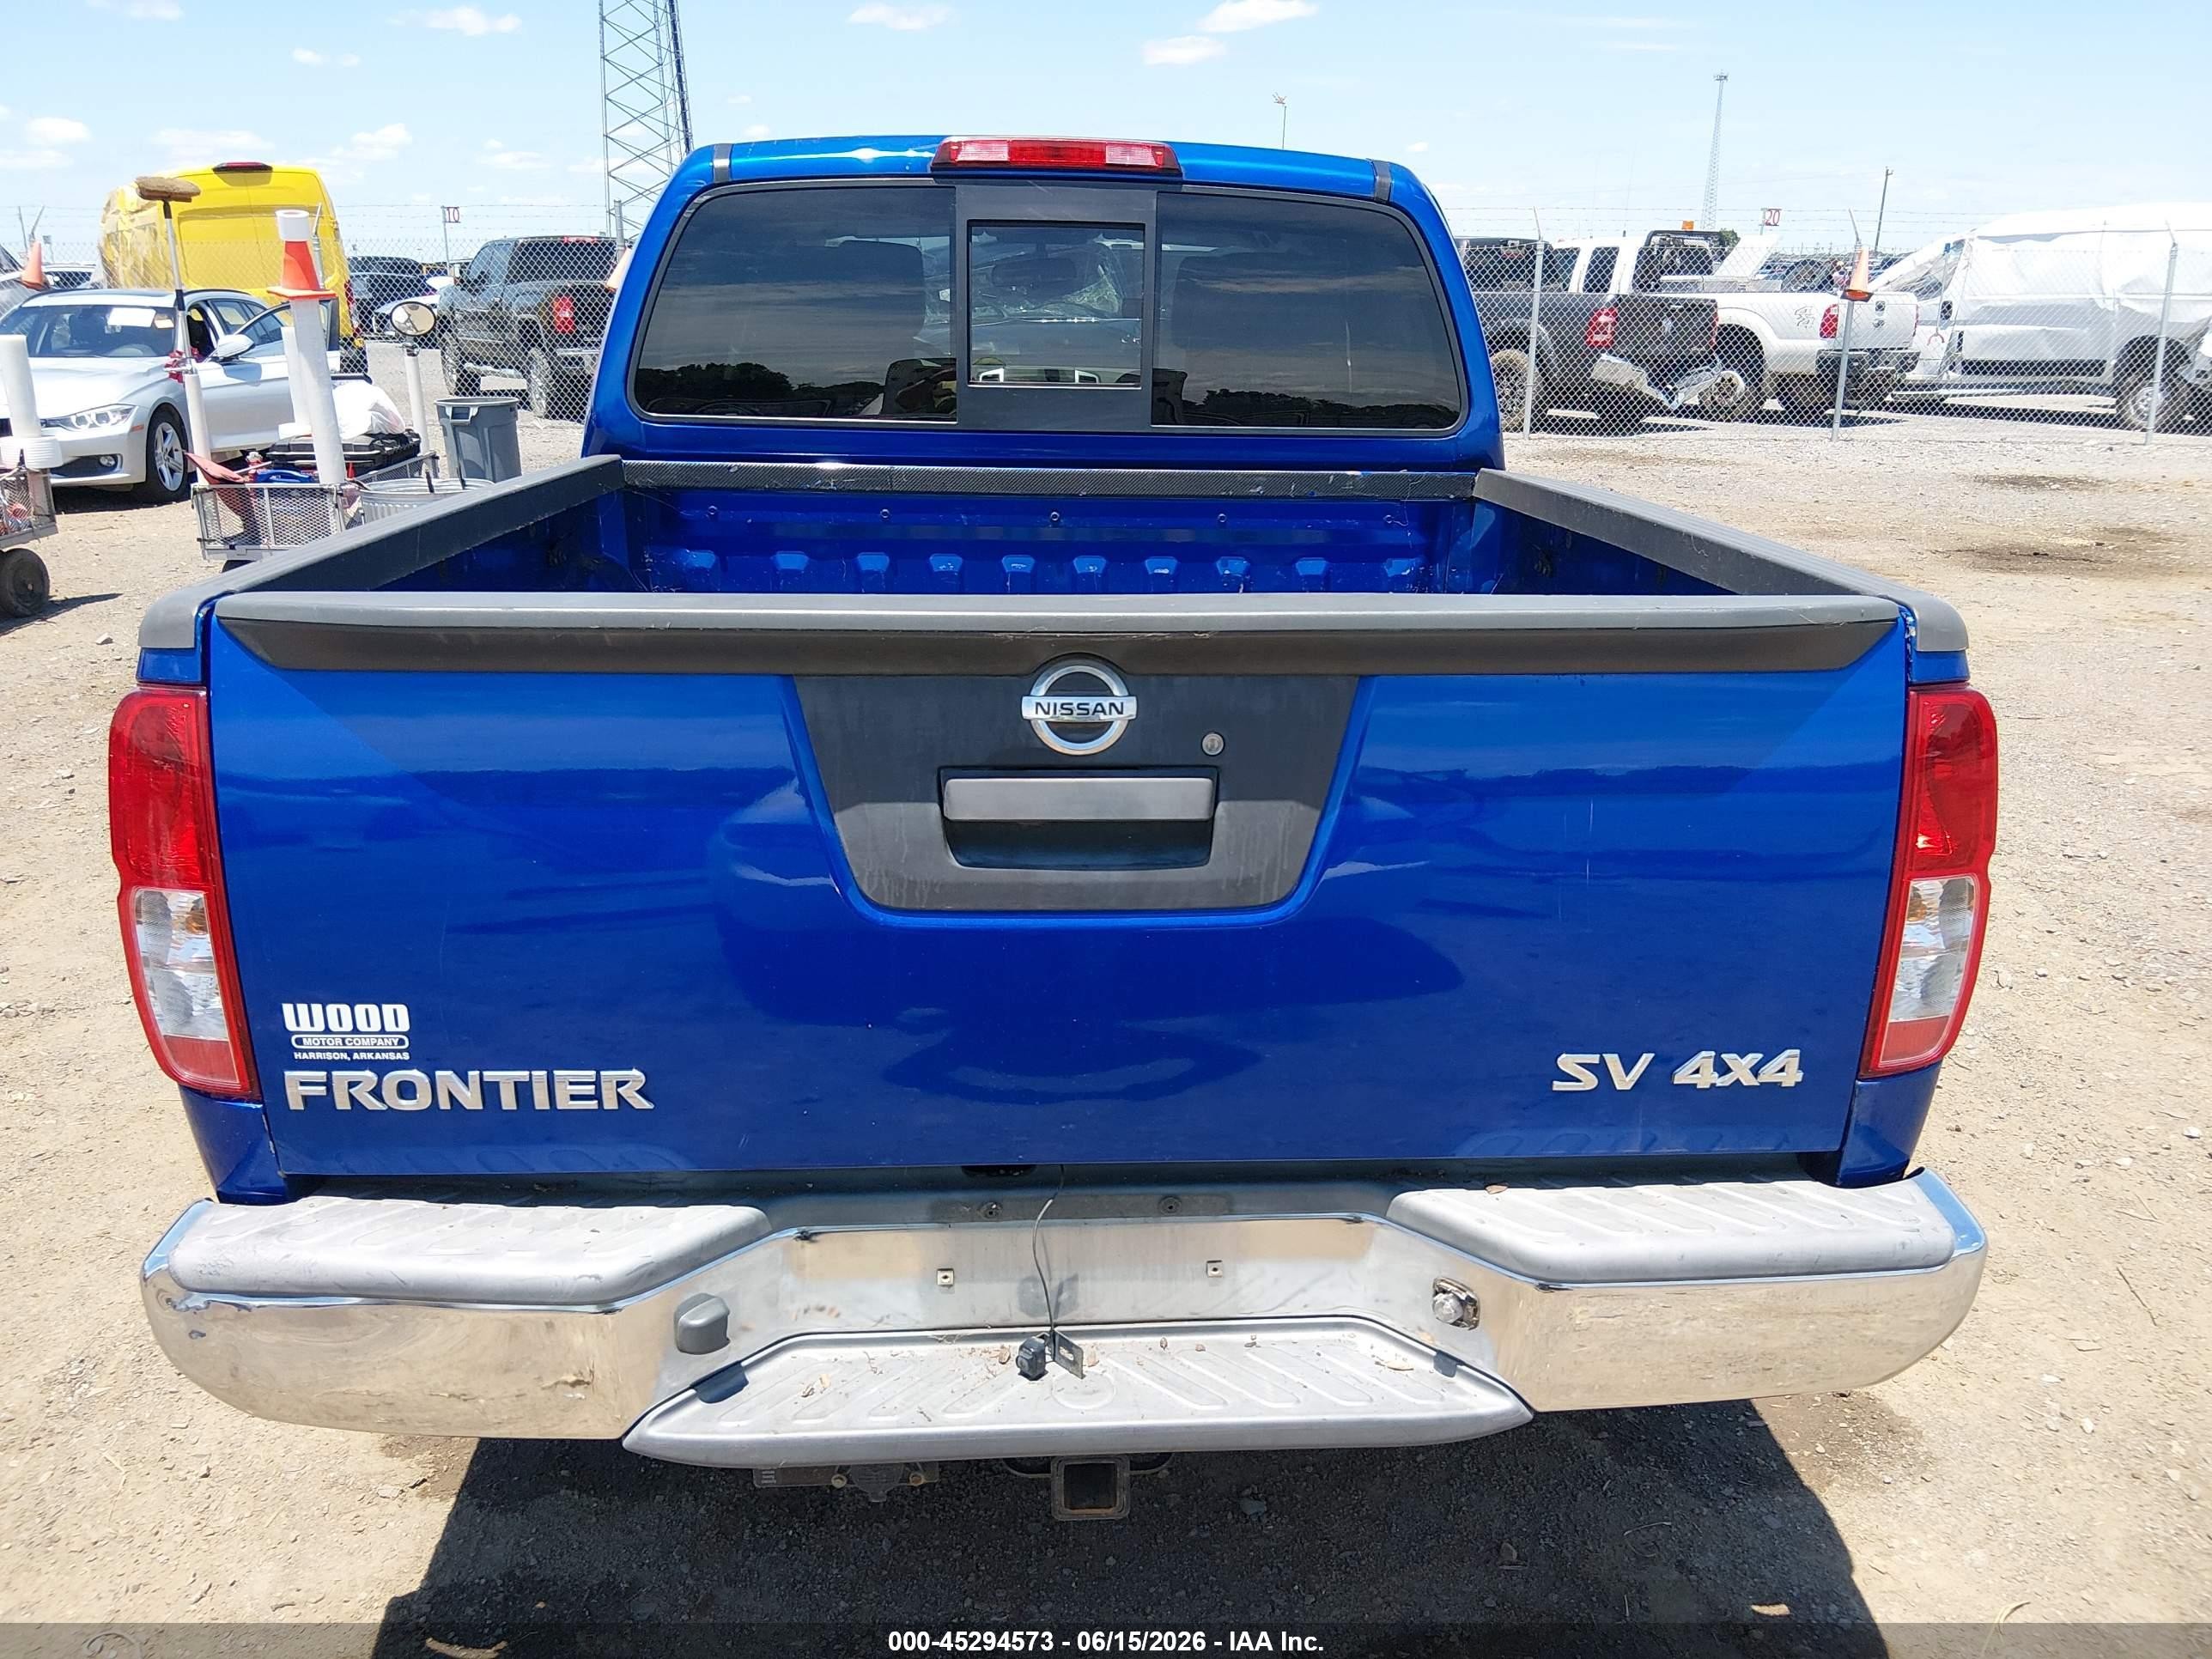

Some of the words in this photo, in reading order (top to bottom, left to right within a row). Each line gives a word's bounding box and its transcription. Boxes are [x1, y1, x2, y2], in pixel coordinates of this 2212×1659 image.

[446, 206, 460, 223] 10
[1764, 208, 1781, 226] 20
[1035, 702, 1124, 716] NISSAN
[282, 1003, 410, 1032] WOOD
[302, 1037, 343, 1046] MOTOR
[345, 1037, 399, 1046] COMPANY
[294, 1052, 350, 1061] HARRISON,
[353, 1052, 410, 1060] ARKANSAS
[1553, 1053, 1656, 1091] SV
[283, 1068, 654, 1111] FRONTIER
